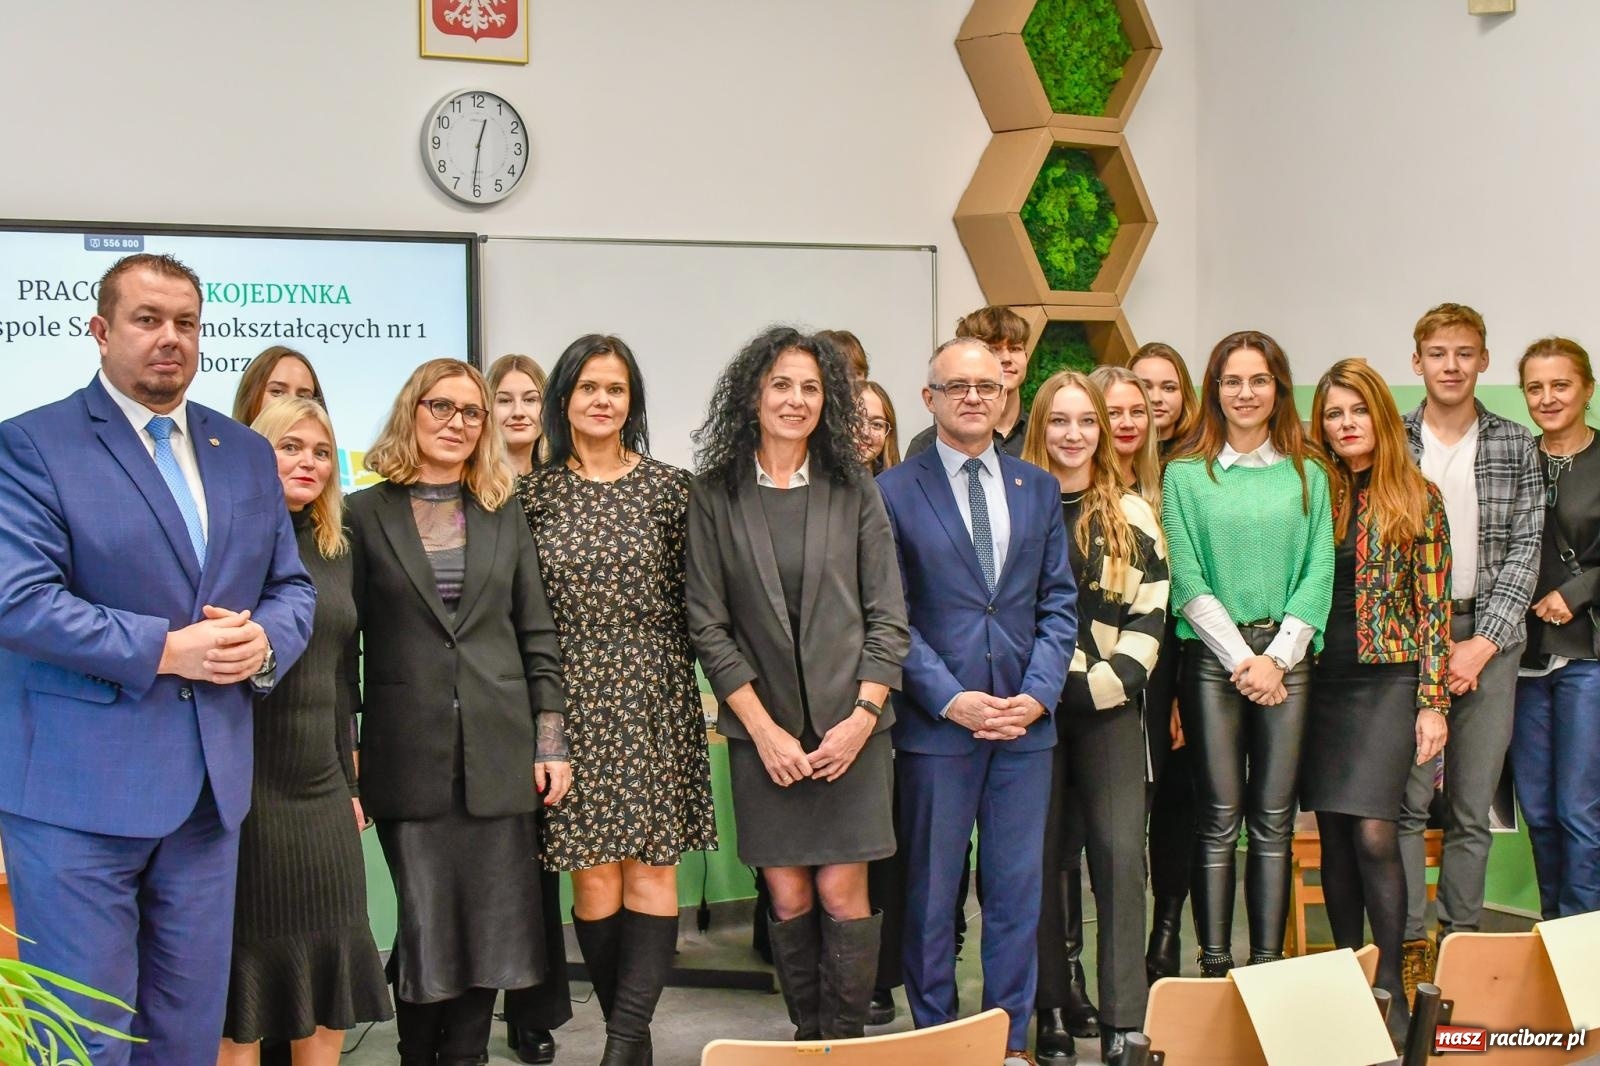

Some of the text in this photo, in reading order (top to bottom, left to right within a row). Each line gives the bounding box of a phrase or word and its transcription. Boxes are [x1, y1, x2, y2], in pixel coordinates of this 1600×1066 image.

[449, 98, 462, 113] 11
[470, 94, 485, 108] 12
[497, 103, 502, 116] 1
[436, 115, 450, 129] 10
[511, 121, 519, 134] 2
[432, 136, 441, 150] 9
[514, 143, 522, 156] 3
[438, 160, 446, 173] 8
[507, 164, 516, 177] 4
[452, 176, 460, 190] 7
[494, 179, 503, 192] 5
[473, 184, 481, 198] 6
[103, 239, 140, 248] 556 800
[18, 280, 352, 307] PRAC KOJEDYNKA
[0, 315, 61, 342] pole
[202, 317, 380, 343] nokształcących
[388, 323, 411, 338] nr
[417, 322, 426, 338] 1
[200, 352, 252, 372] borz
